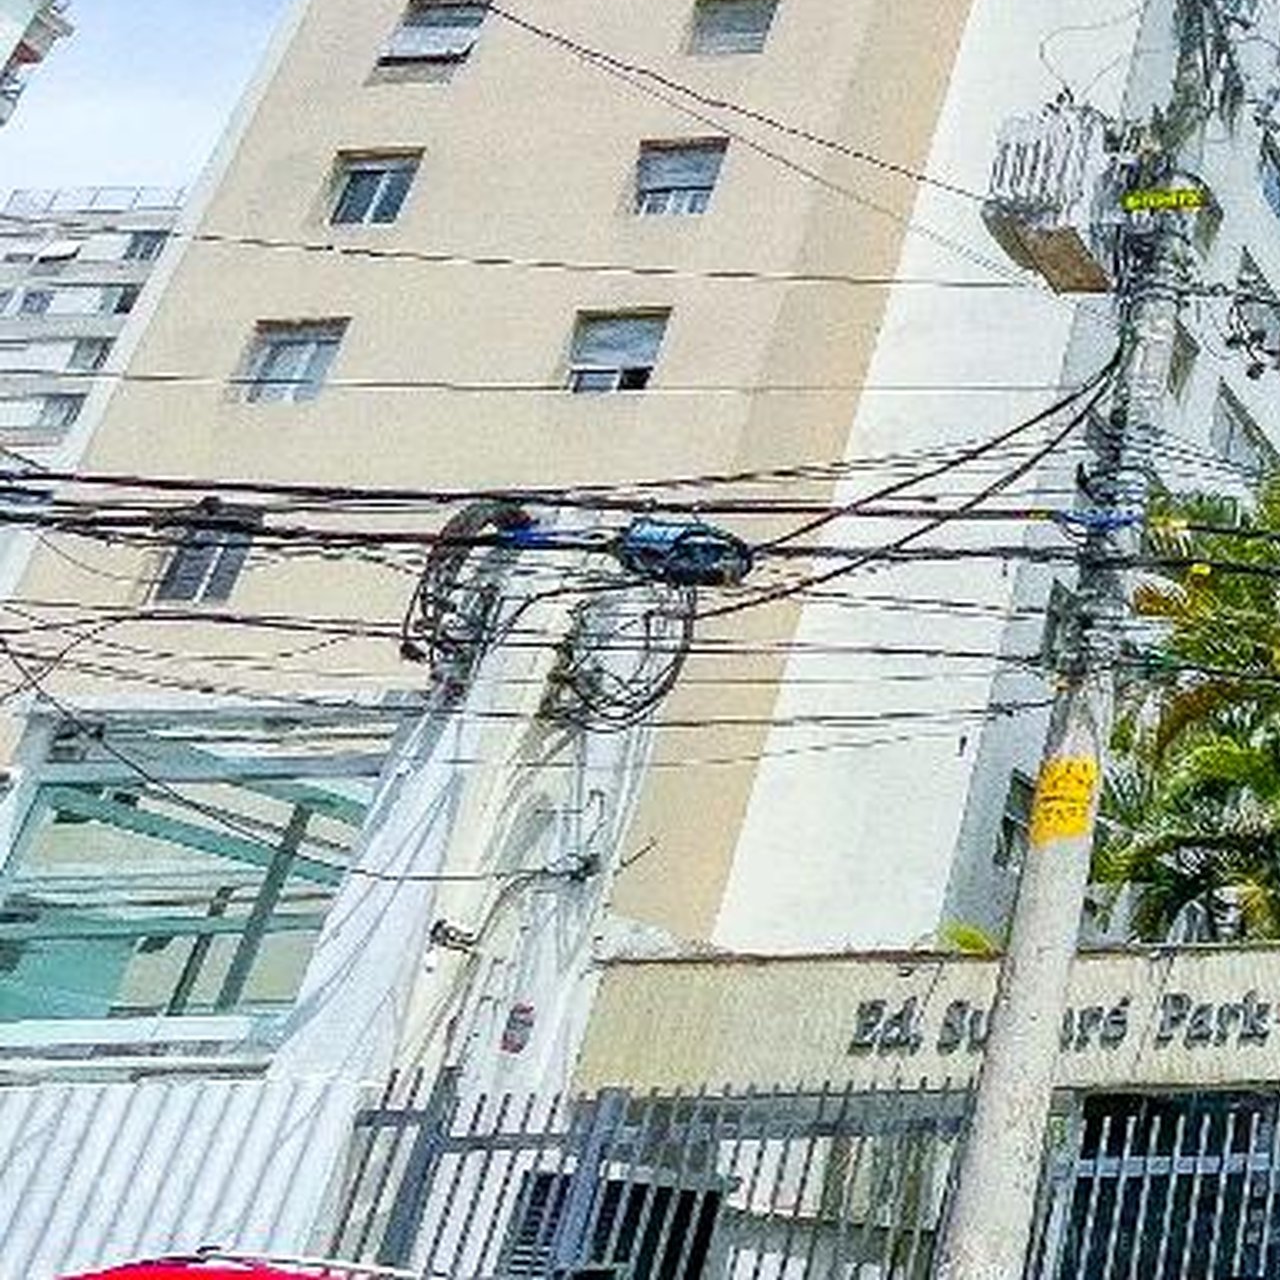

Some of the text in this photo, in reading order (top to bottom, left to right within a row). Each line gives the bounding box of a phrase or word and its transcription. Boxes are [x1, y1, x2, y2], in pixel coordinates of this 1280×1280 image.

[848, 996, 921, 1055] Ed.
[937, 997, 1129, 1054] Suré
[1154, 990, 1269, 1049] Park
